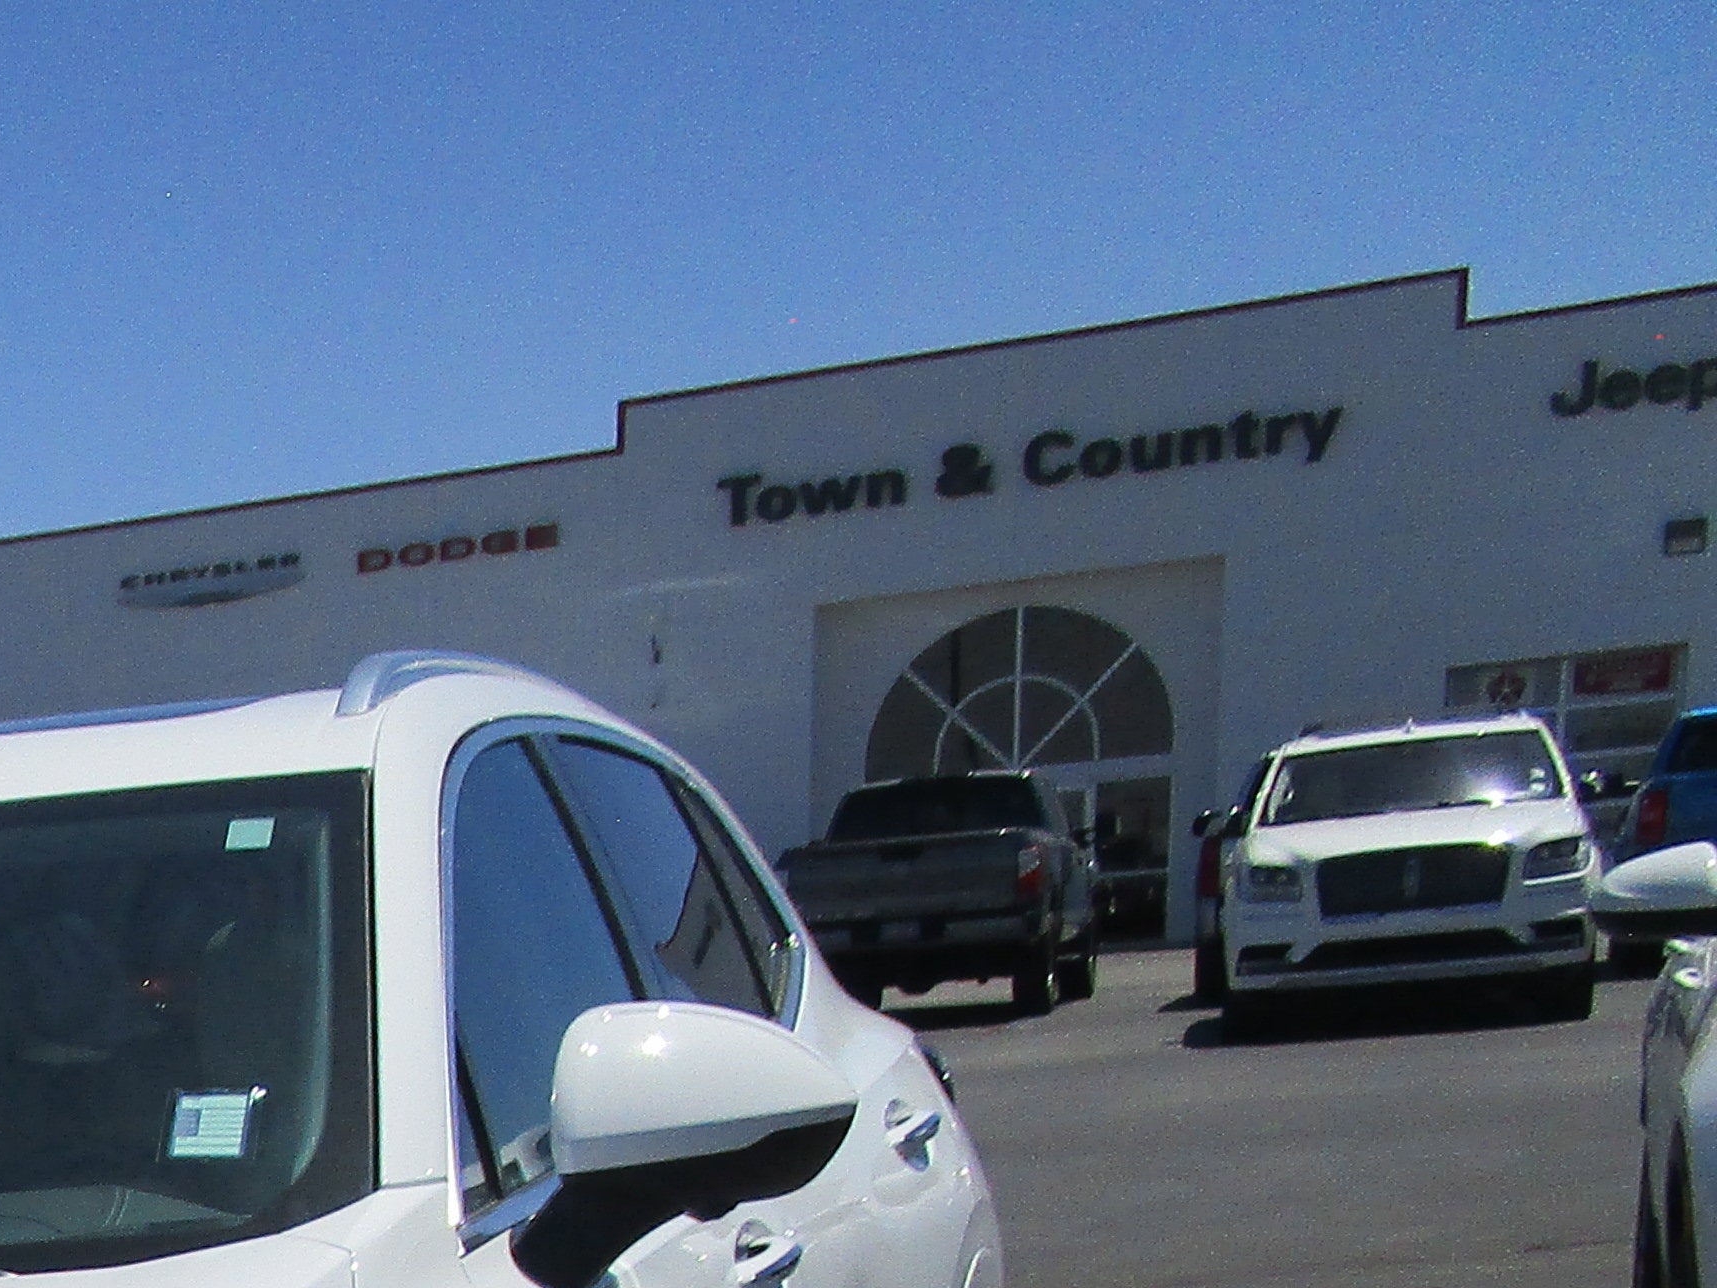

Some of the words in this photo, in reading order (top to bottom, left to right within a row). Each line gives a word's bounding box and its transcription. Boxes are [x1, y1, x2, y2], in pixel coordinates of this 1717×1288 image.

[717, 468, 907, 527] Town
[935, 443, 994, 498] &
[1023, 406, 1344, 488] Country
[357, 523, 558, 575] DODGE
